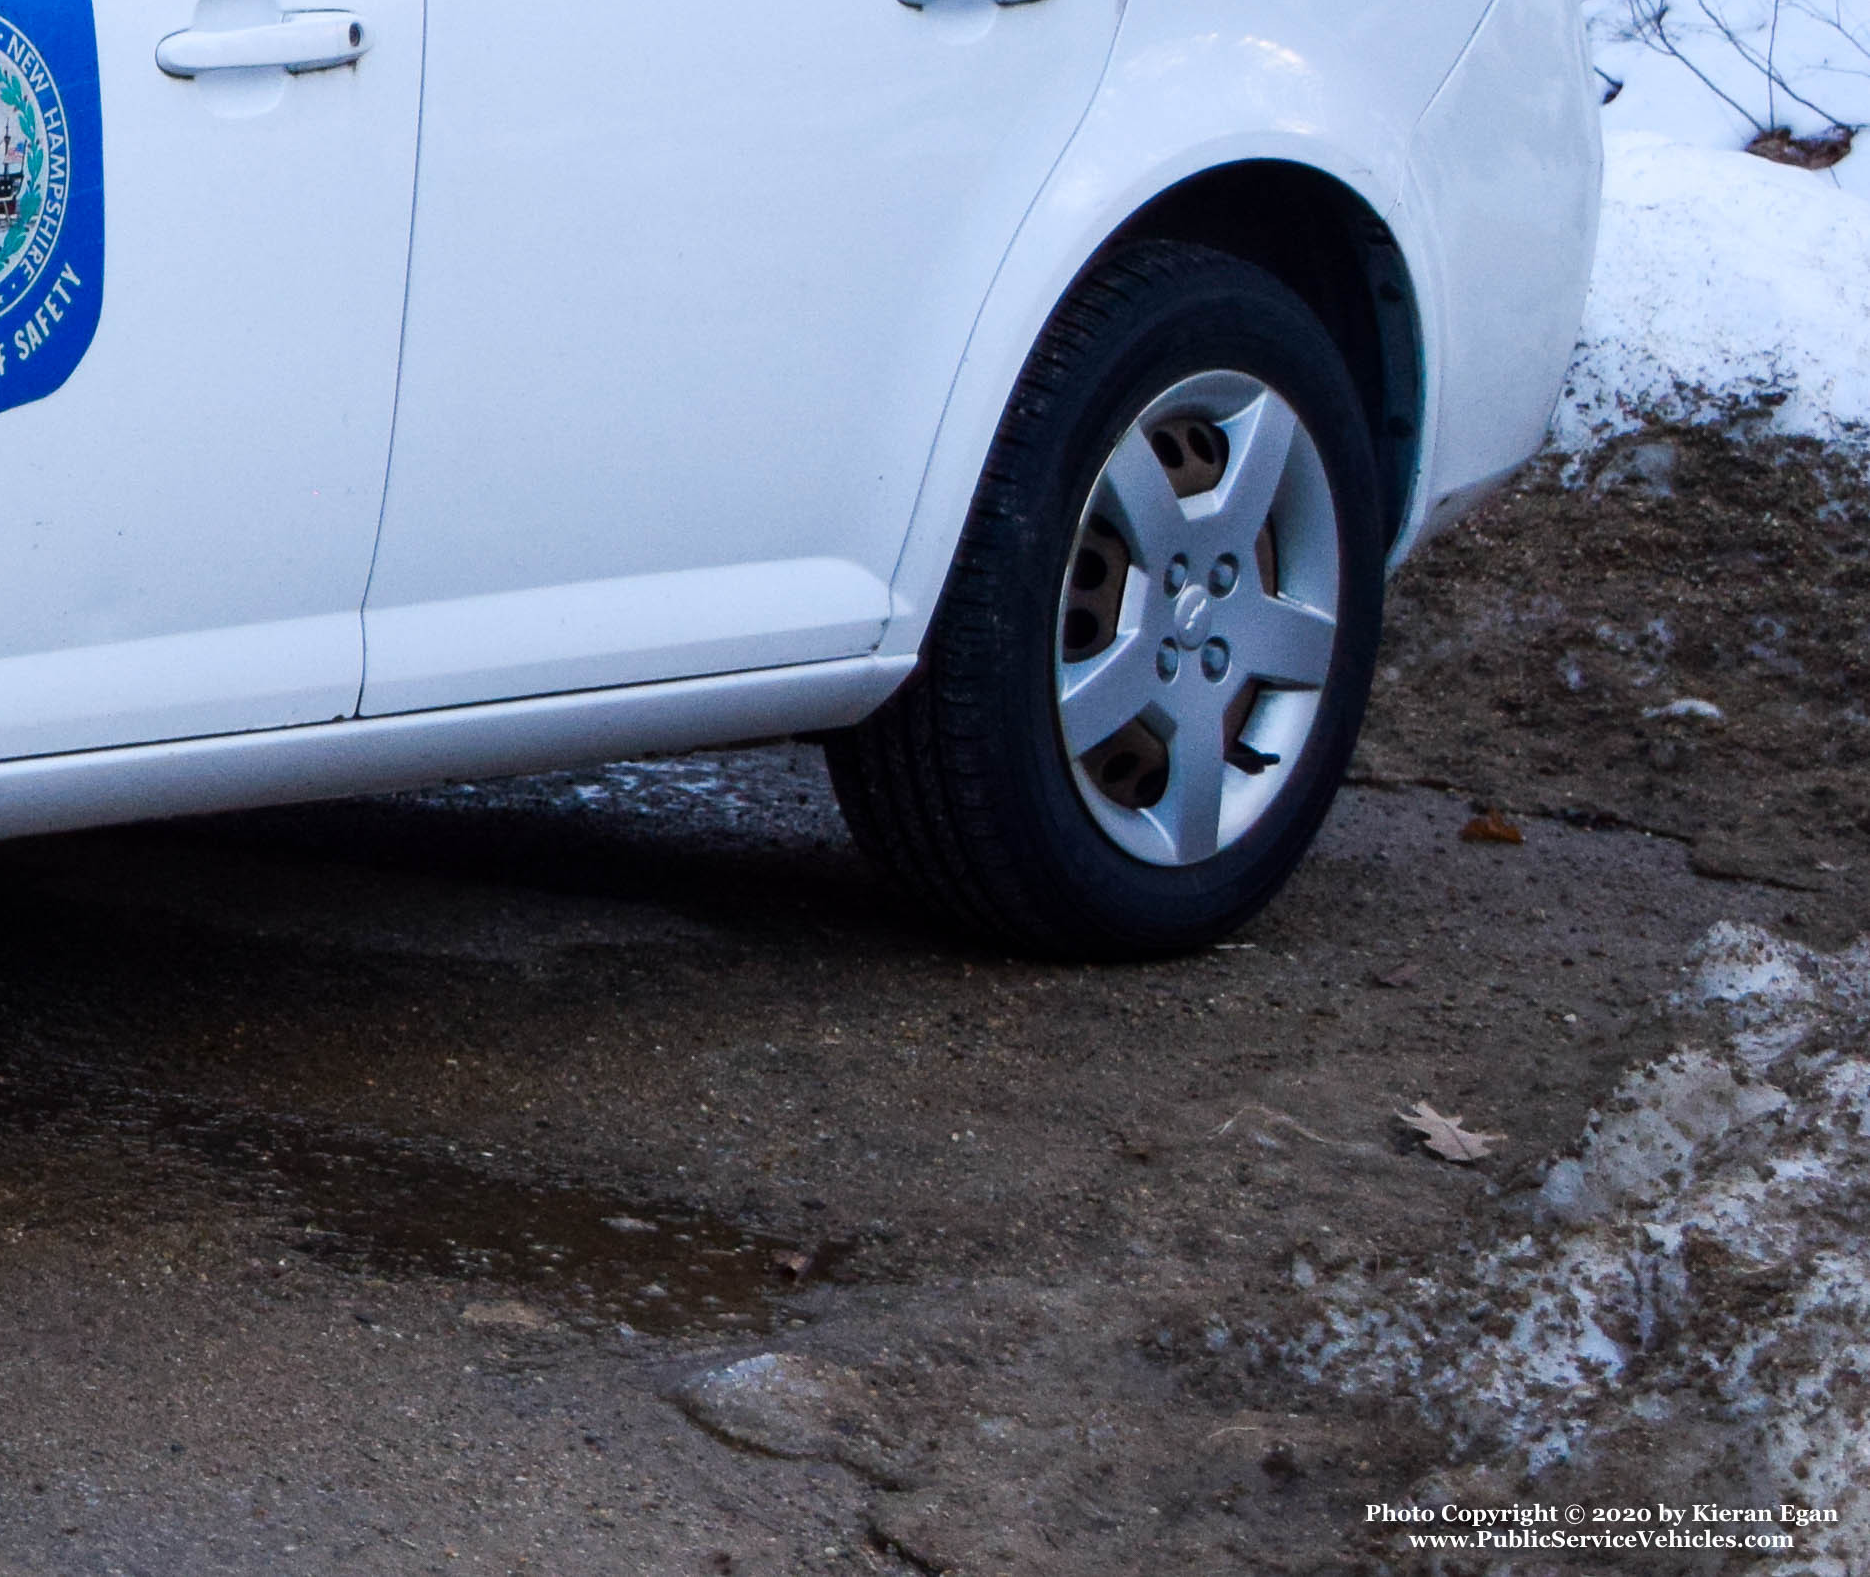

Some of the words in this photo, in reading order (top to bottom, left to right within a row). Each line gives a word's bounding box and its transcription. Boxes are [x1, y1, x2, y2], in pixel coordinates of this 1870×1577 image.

[6, 34, 49, 93] NEW
[21, 107, 65, 284] HAMPSHIRE
[14, 263, 82, 362] SAFETY
